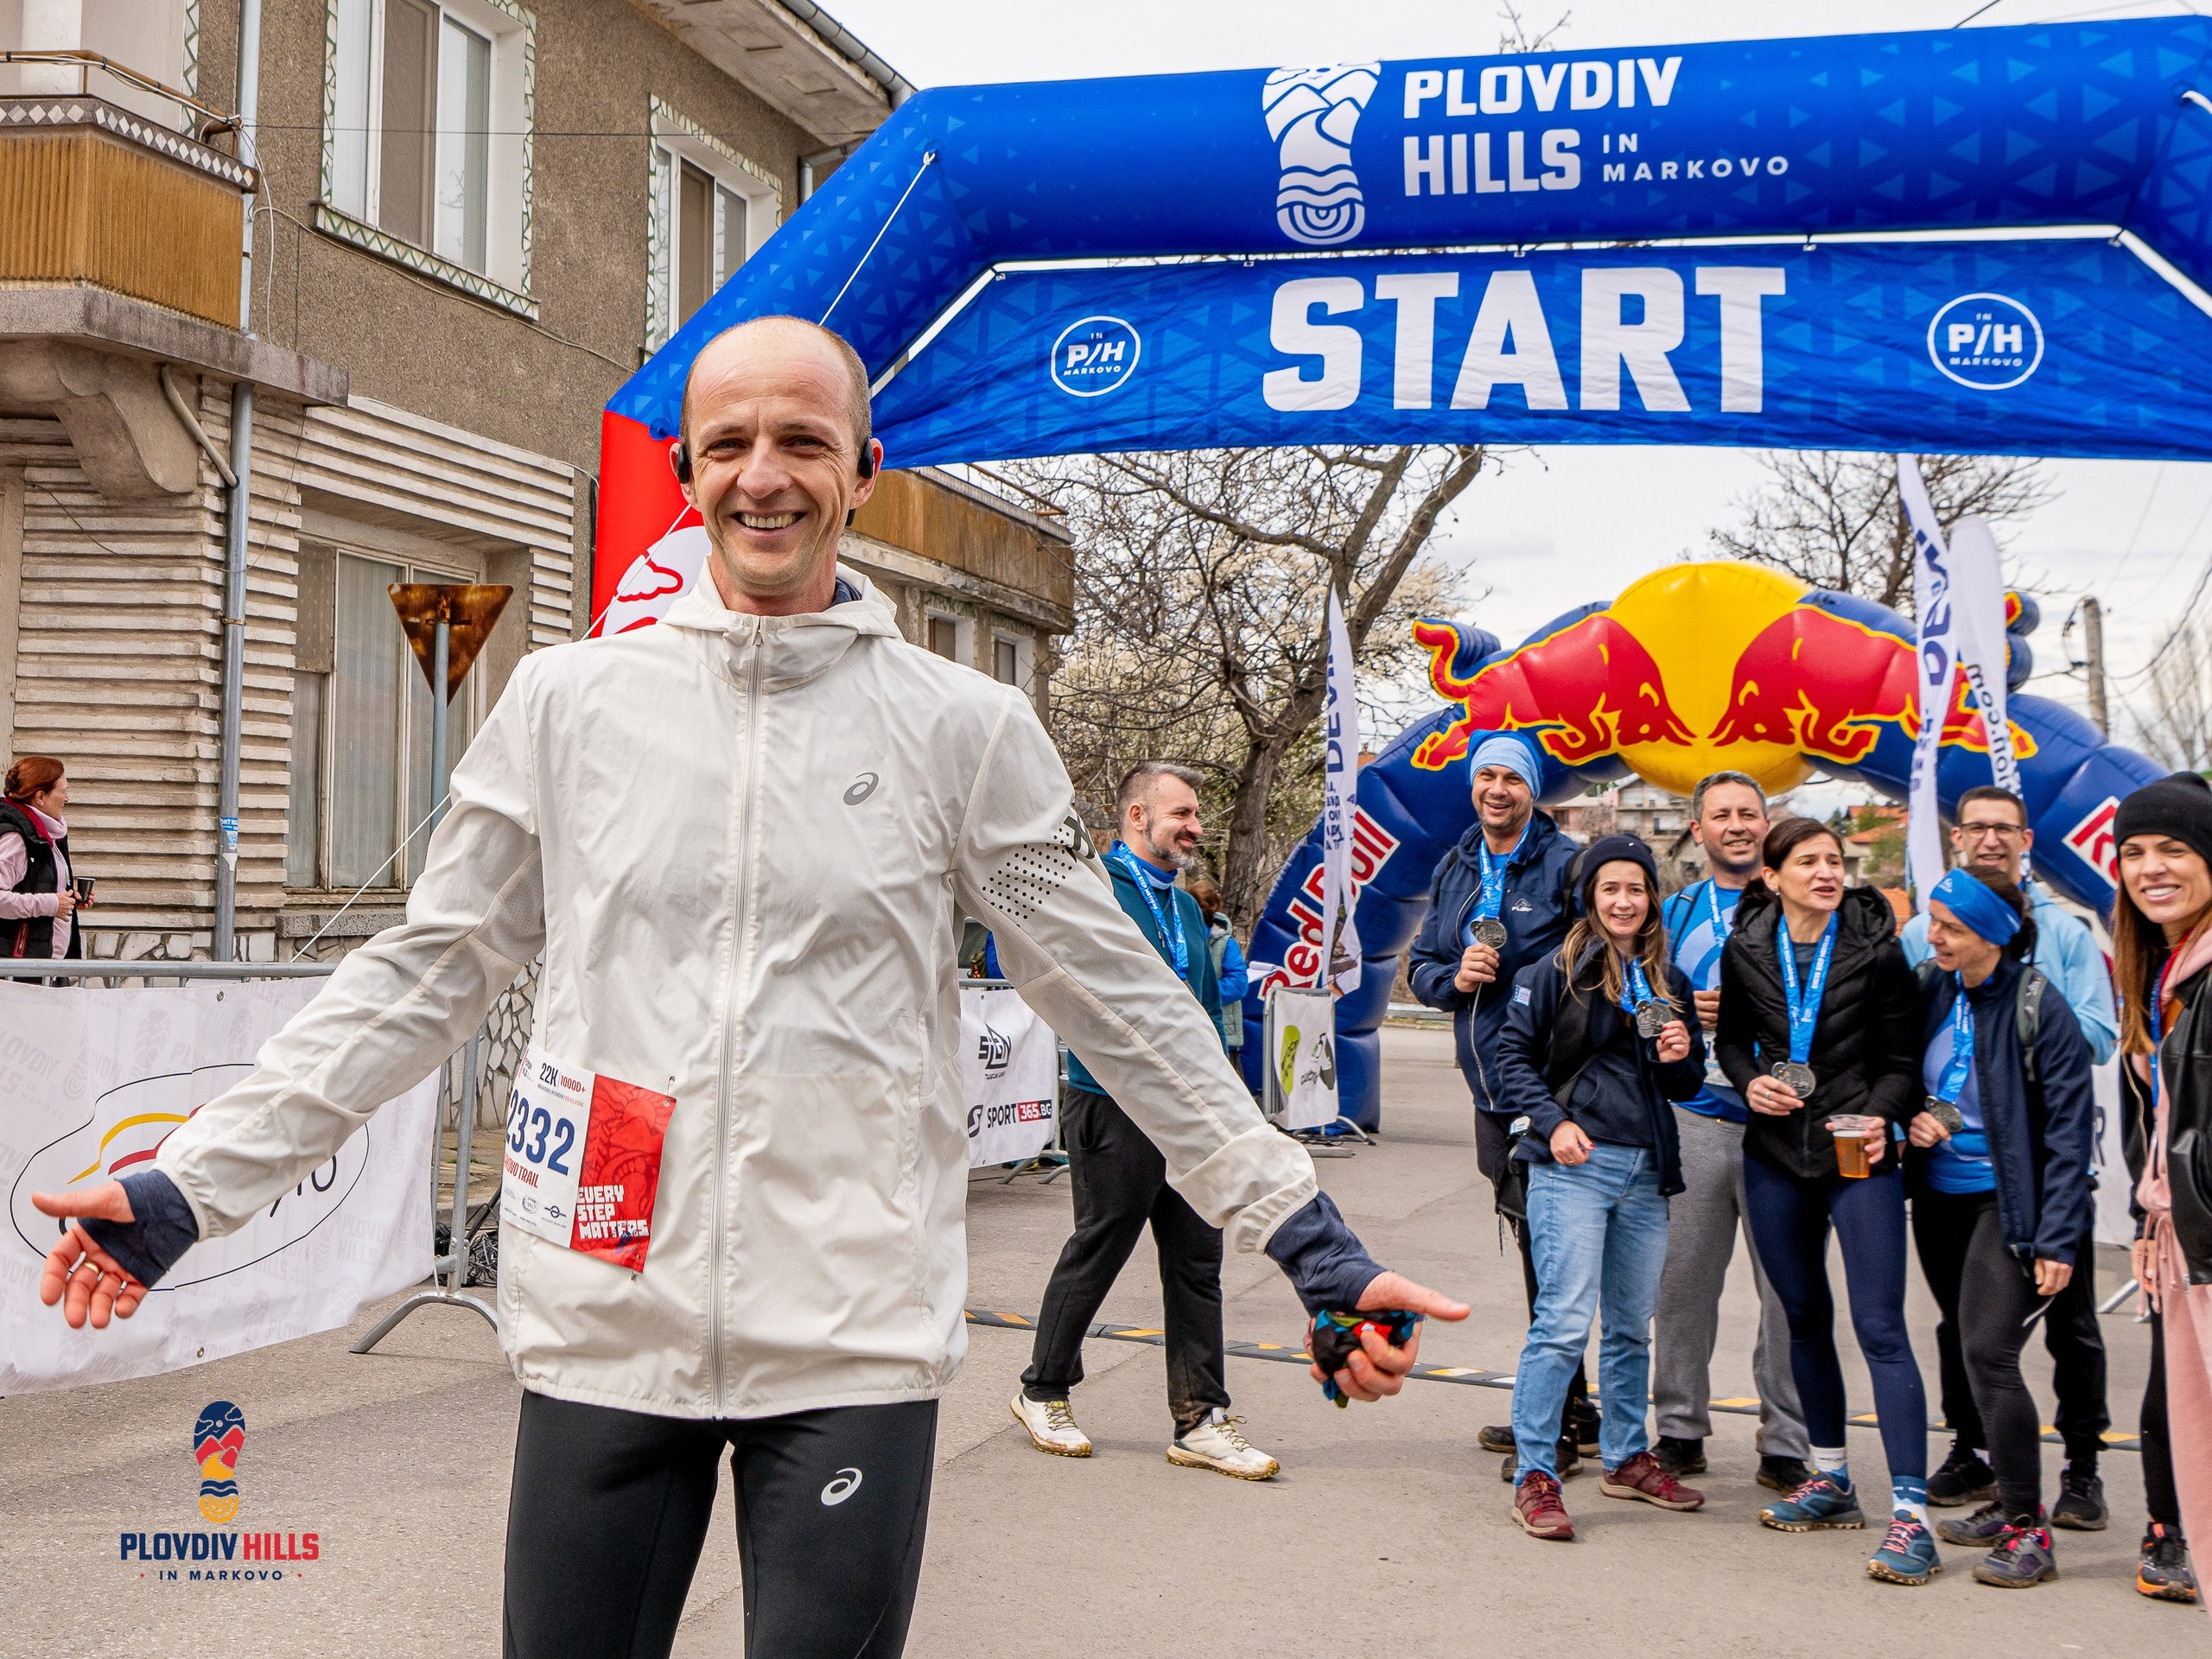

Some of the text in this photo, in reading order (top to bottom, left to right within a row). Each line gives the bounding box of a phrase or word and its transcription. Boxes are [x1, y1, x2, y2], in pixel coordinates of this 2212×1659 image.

[1404, 56, 1682, 118] PLOVDIV
[1603, 133, 1638, 154] IN
[1404, 129, 1580, 197] HILLS
[1603, 156, 1789, 182] MARKOVO
[1262, 266, 1787, 413] START
[1948, 323, 2023, 356] P/H
[1067, 340, 1126, 369] P/H
[1949, 357, 2023, 366] MARKOVO
[1063, 365, 1122, 376] MARKOVO
[539, 1062, 558, 1087] 22K
[506, 1089, 575, 1176] 2332
[518, 1165, 539, 1189] TRAIL
[576, 1185, 625, 1204] EVERY
[576, 1203, 616, 1221] STEP
[578, 1219, 650, 1239] MATTERS
